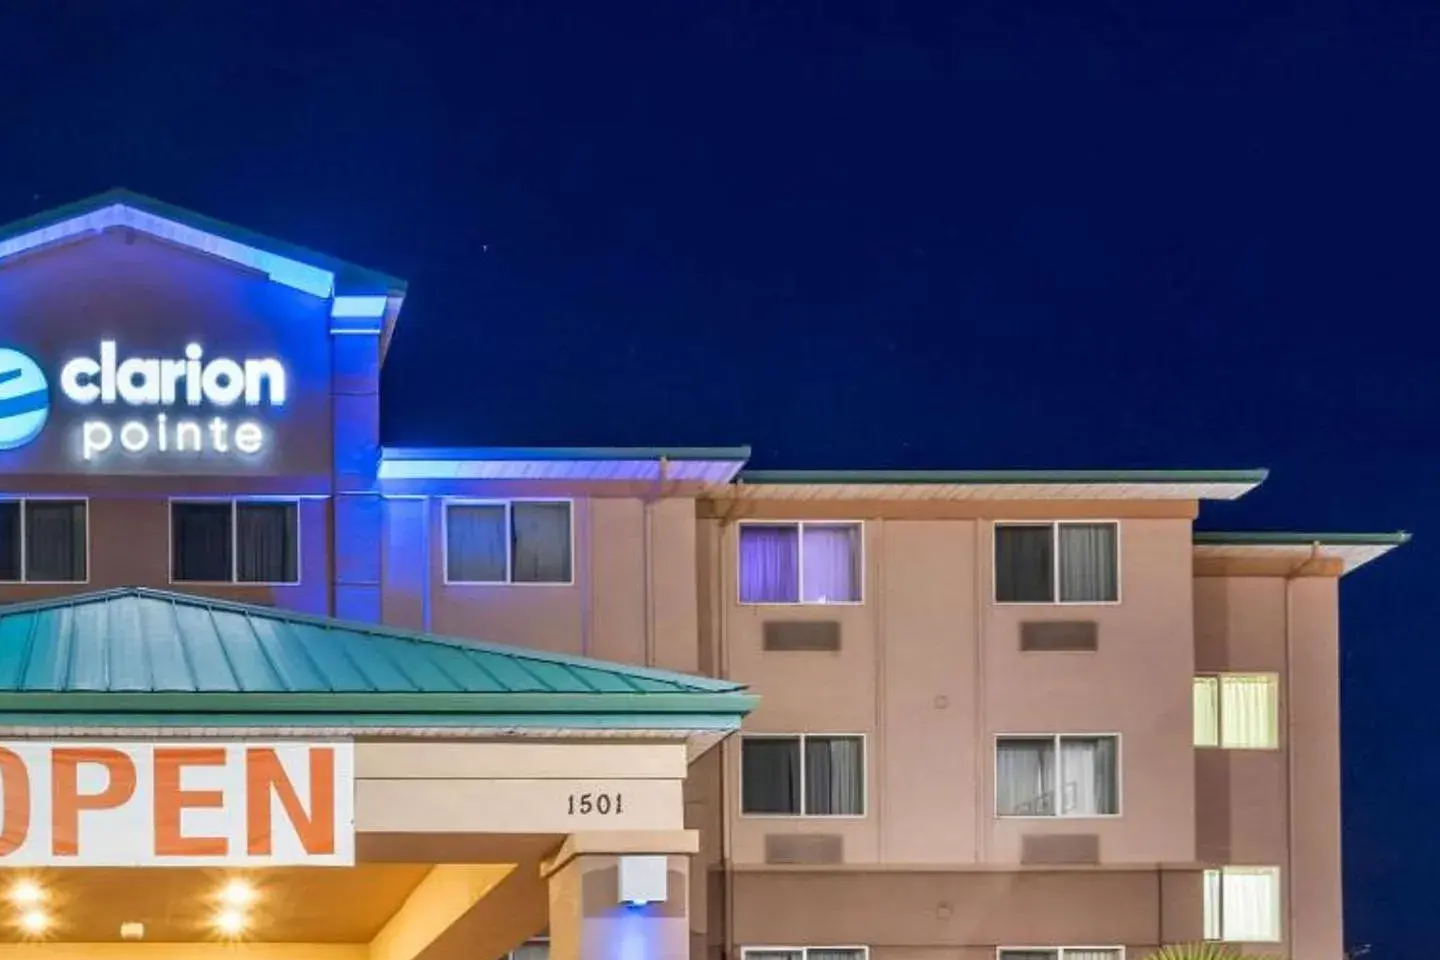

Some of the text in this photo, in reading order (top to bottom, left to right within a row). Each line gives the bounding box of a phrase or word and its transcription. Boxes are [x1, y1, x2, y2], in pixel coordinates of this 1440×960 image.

[60, 340, 286, 406] clarion
[82, 413, 263, 460] pointe
[567, 793, 624, 815] 1501
